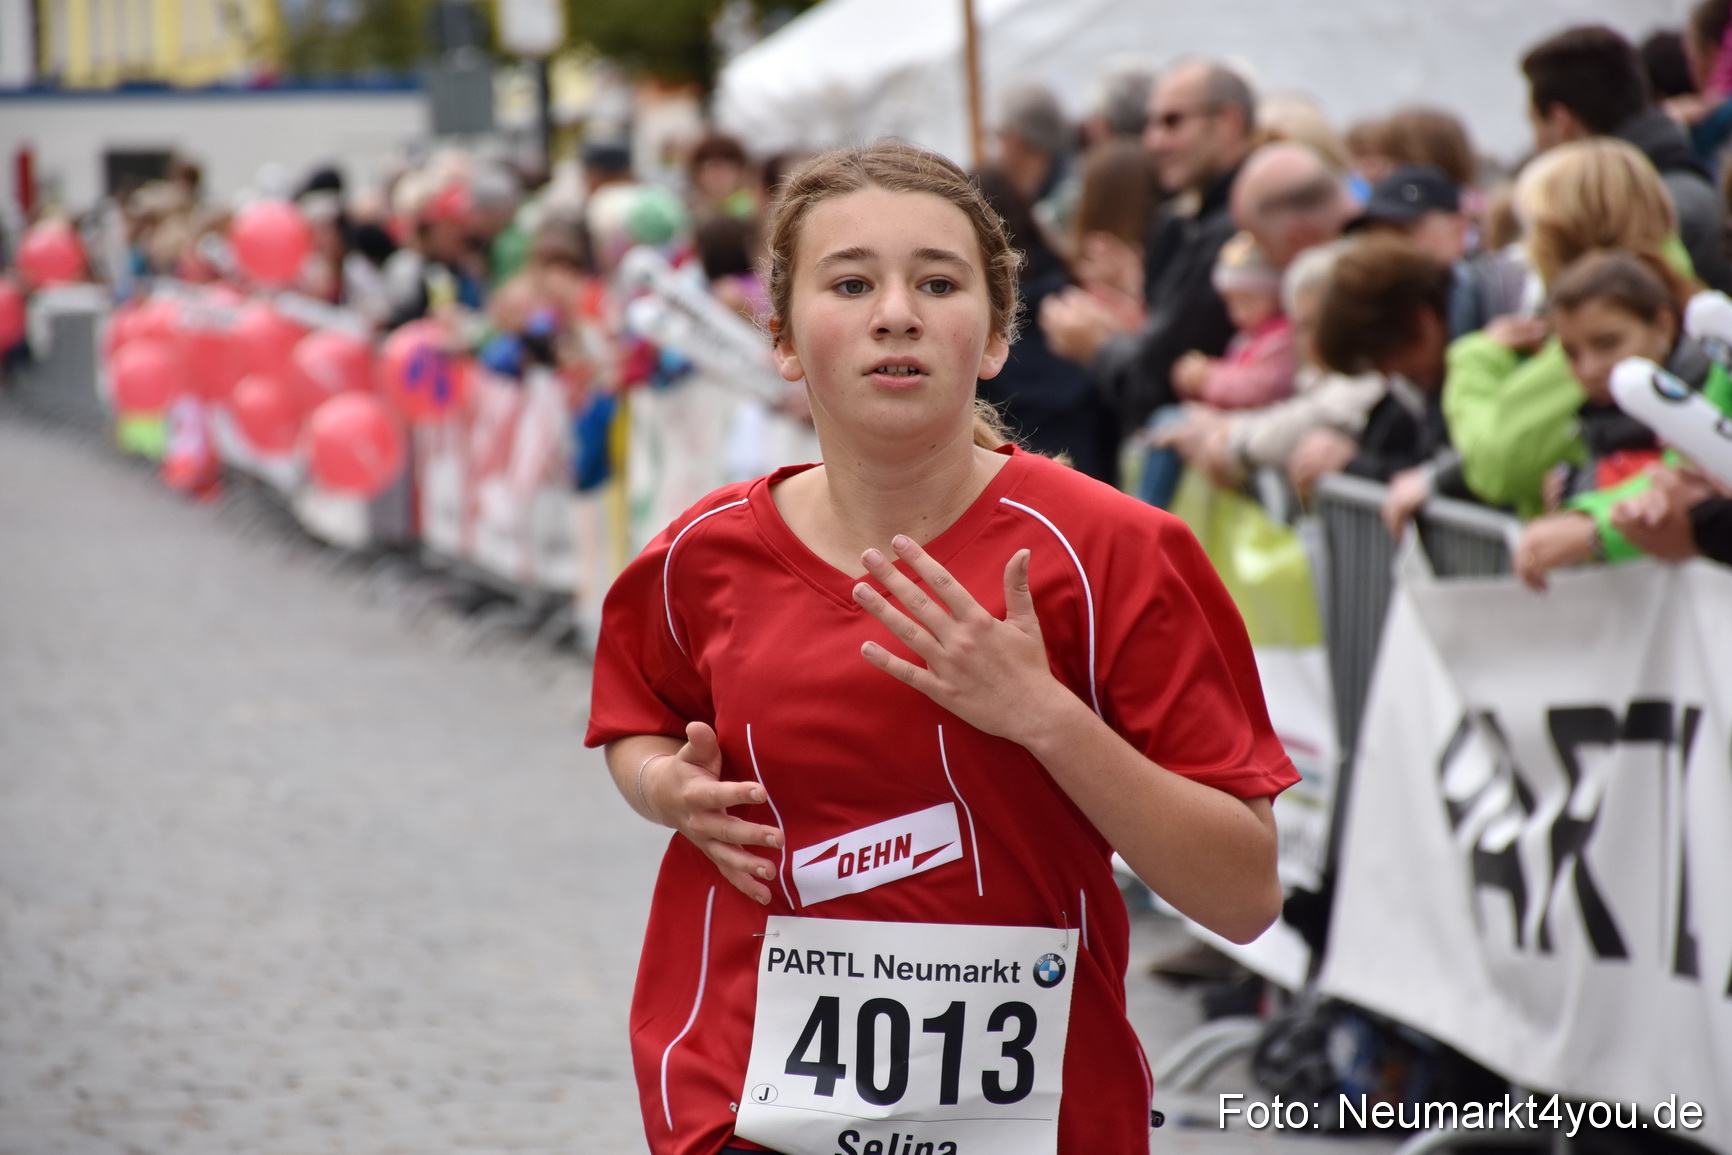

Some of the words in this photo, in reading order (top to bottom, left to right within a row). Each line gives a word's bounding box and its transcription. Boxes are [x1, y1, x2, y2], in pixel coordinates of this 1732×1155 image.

[837, 832, 912, 880] DEHN
[767, 947, 865, 978] PARTL
[873, 954, 1021, 984] Neumarkt
[784, 995, 1038, 1106] 4013
[758, 1087, 770, 1101] J
